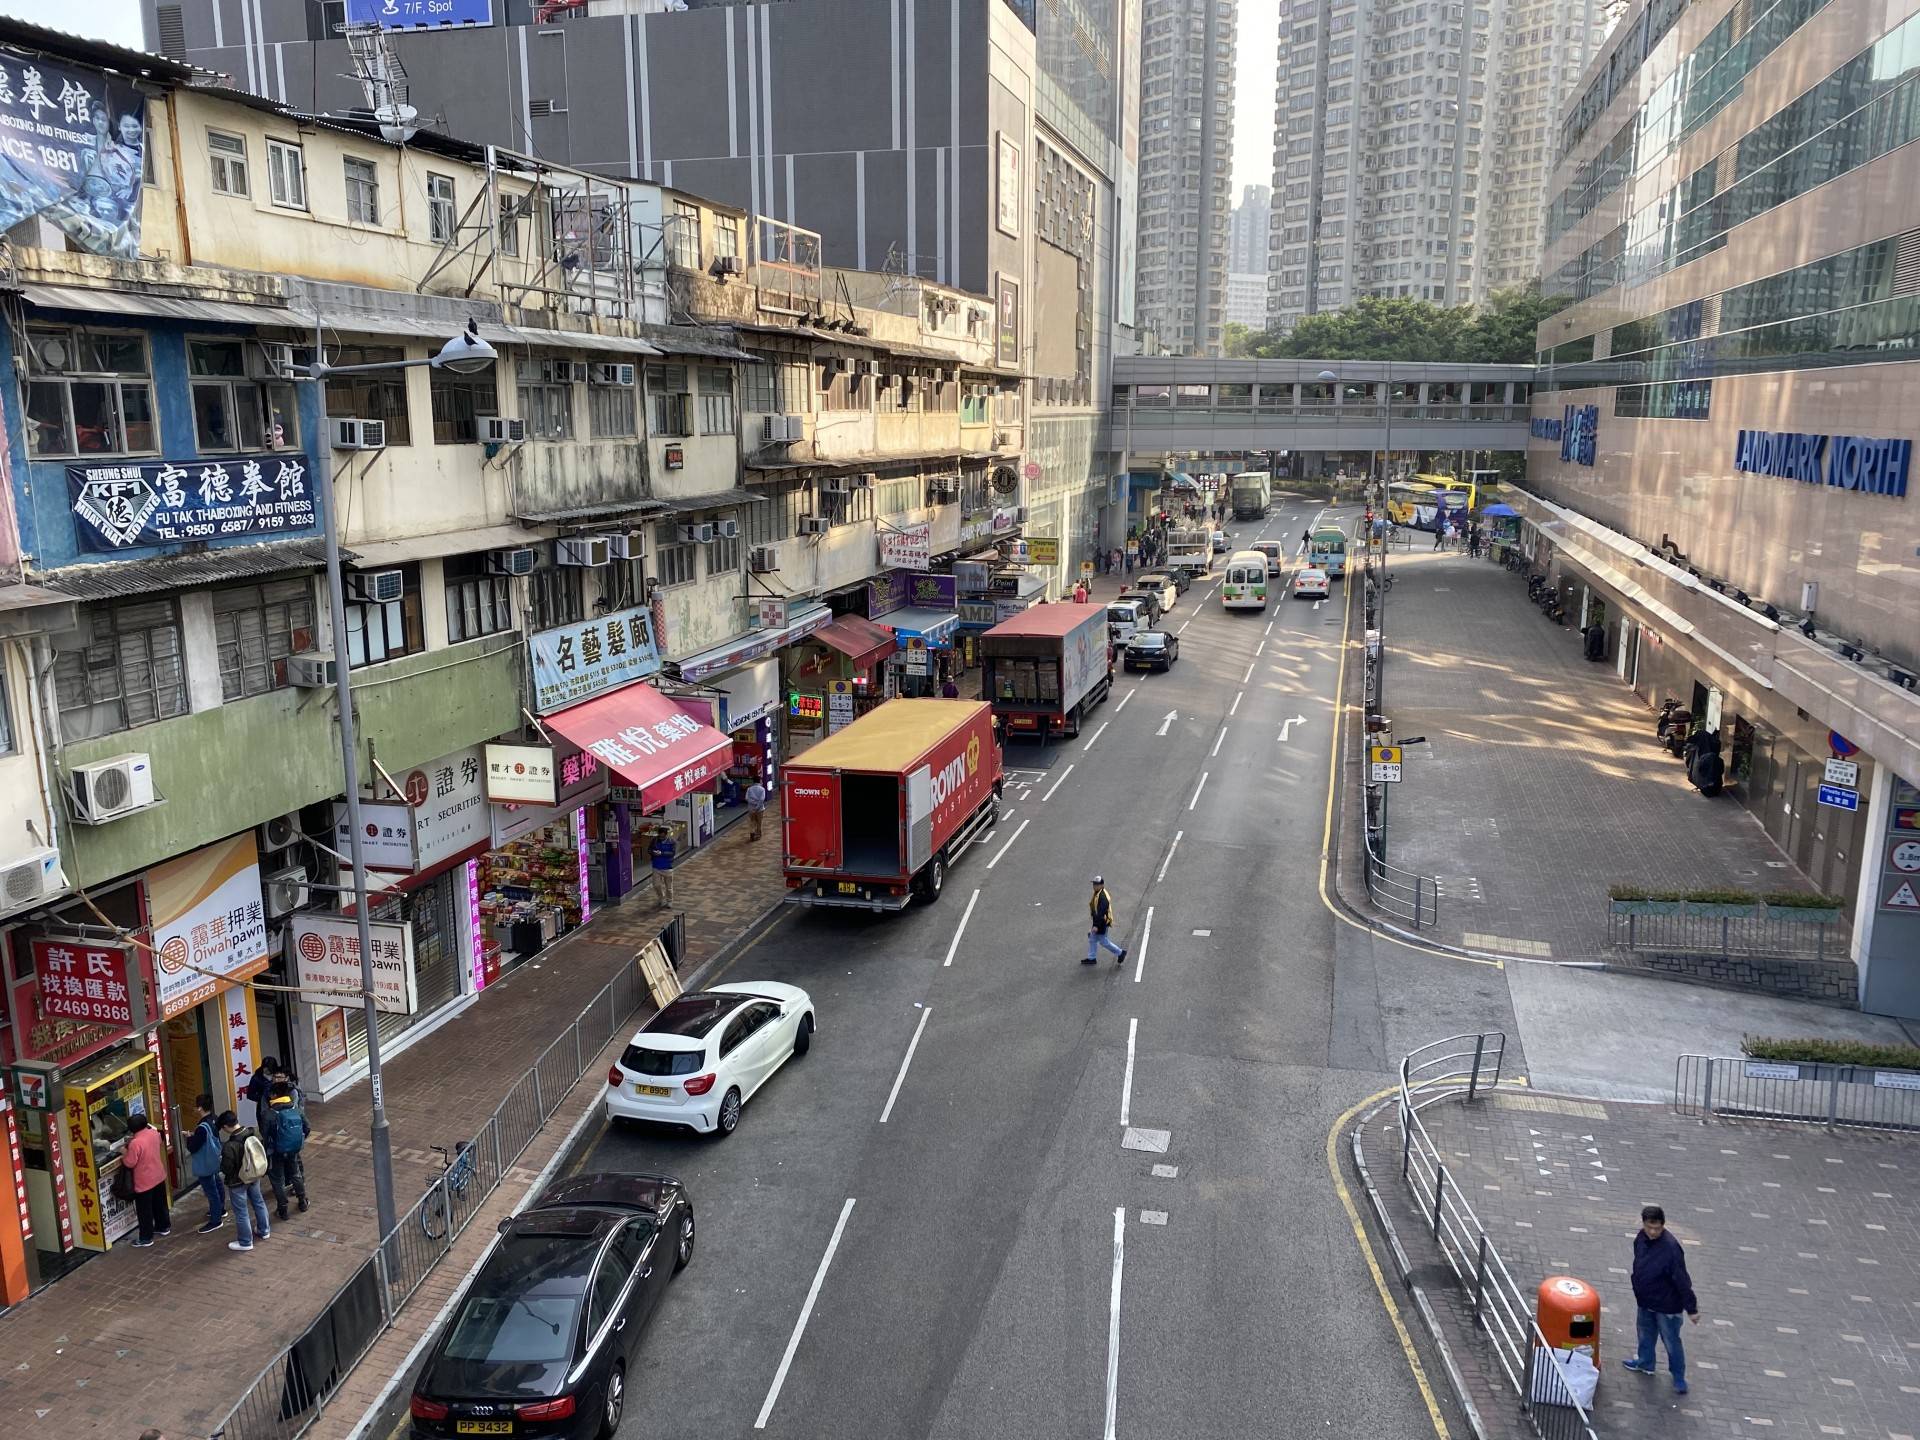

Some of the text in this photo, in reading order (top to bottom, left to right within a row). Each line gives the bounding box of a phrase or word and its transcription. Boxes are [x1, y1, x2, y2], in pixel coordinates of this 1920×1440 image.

[404, 1, 453, 16] 7/F, Spot
[36, 123, 54, 137] AND
[54, 127, 88, 145] FITNESS
[37, 145, 79, 173] 1981
[86, 467, 142, 480] SHEUNG SHUI
[1734, 430, 1912, 498] LANDMARK NORTH
[92, 482, 142, 498] KF1
[155, 460, 306, 508] 富德拳館
[74, 504, 124, 547] MUAY THAI
[127, 496, 161, 545] BOXING
[155, 500, 311, 525] FU TAK THAIBOXING AND FITNESS
[258, 515, 285, 528] 9159
[289, 512, 315, 525] 3263
[958, 605, 994, 623] AME
[557, 614, 650, 675] 名藝髮廊
[588, 713, 704, 767] 雅悅藥妝
[435, 757, 479, 799] 證券
[528, 765, 552, 776] 證券
[1382, 764, 1400, 772] 8-10
[1382, 772, 1397, 780] 5-7
[793, 788, 821, 796] CROWN
[930, 751, 965, 812] ROWN
[437, 793, 481, 823] SECURITIES
[930, 777, 979, 832] OGISTICS
[382, 827, 407, 839] 證券
[192, 923, 264, 964] Oiwahpawn
[47, 947, 113, 978] 許氏
[330, 953, 401, 972] Oiwapawn
[42, 972, 127, 1003] 找換匯款
[165, 997, 190, 1016] 6699
[192, 983, 217, 1002] 2228
[54, 999, 130, 1021] 2469 9368
[460, 1421, 509, 1432] PP 9432
